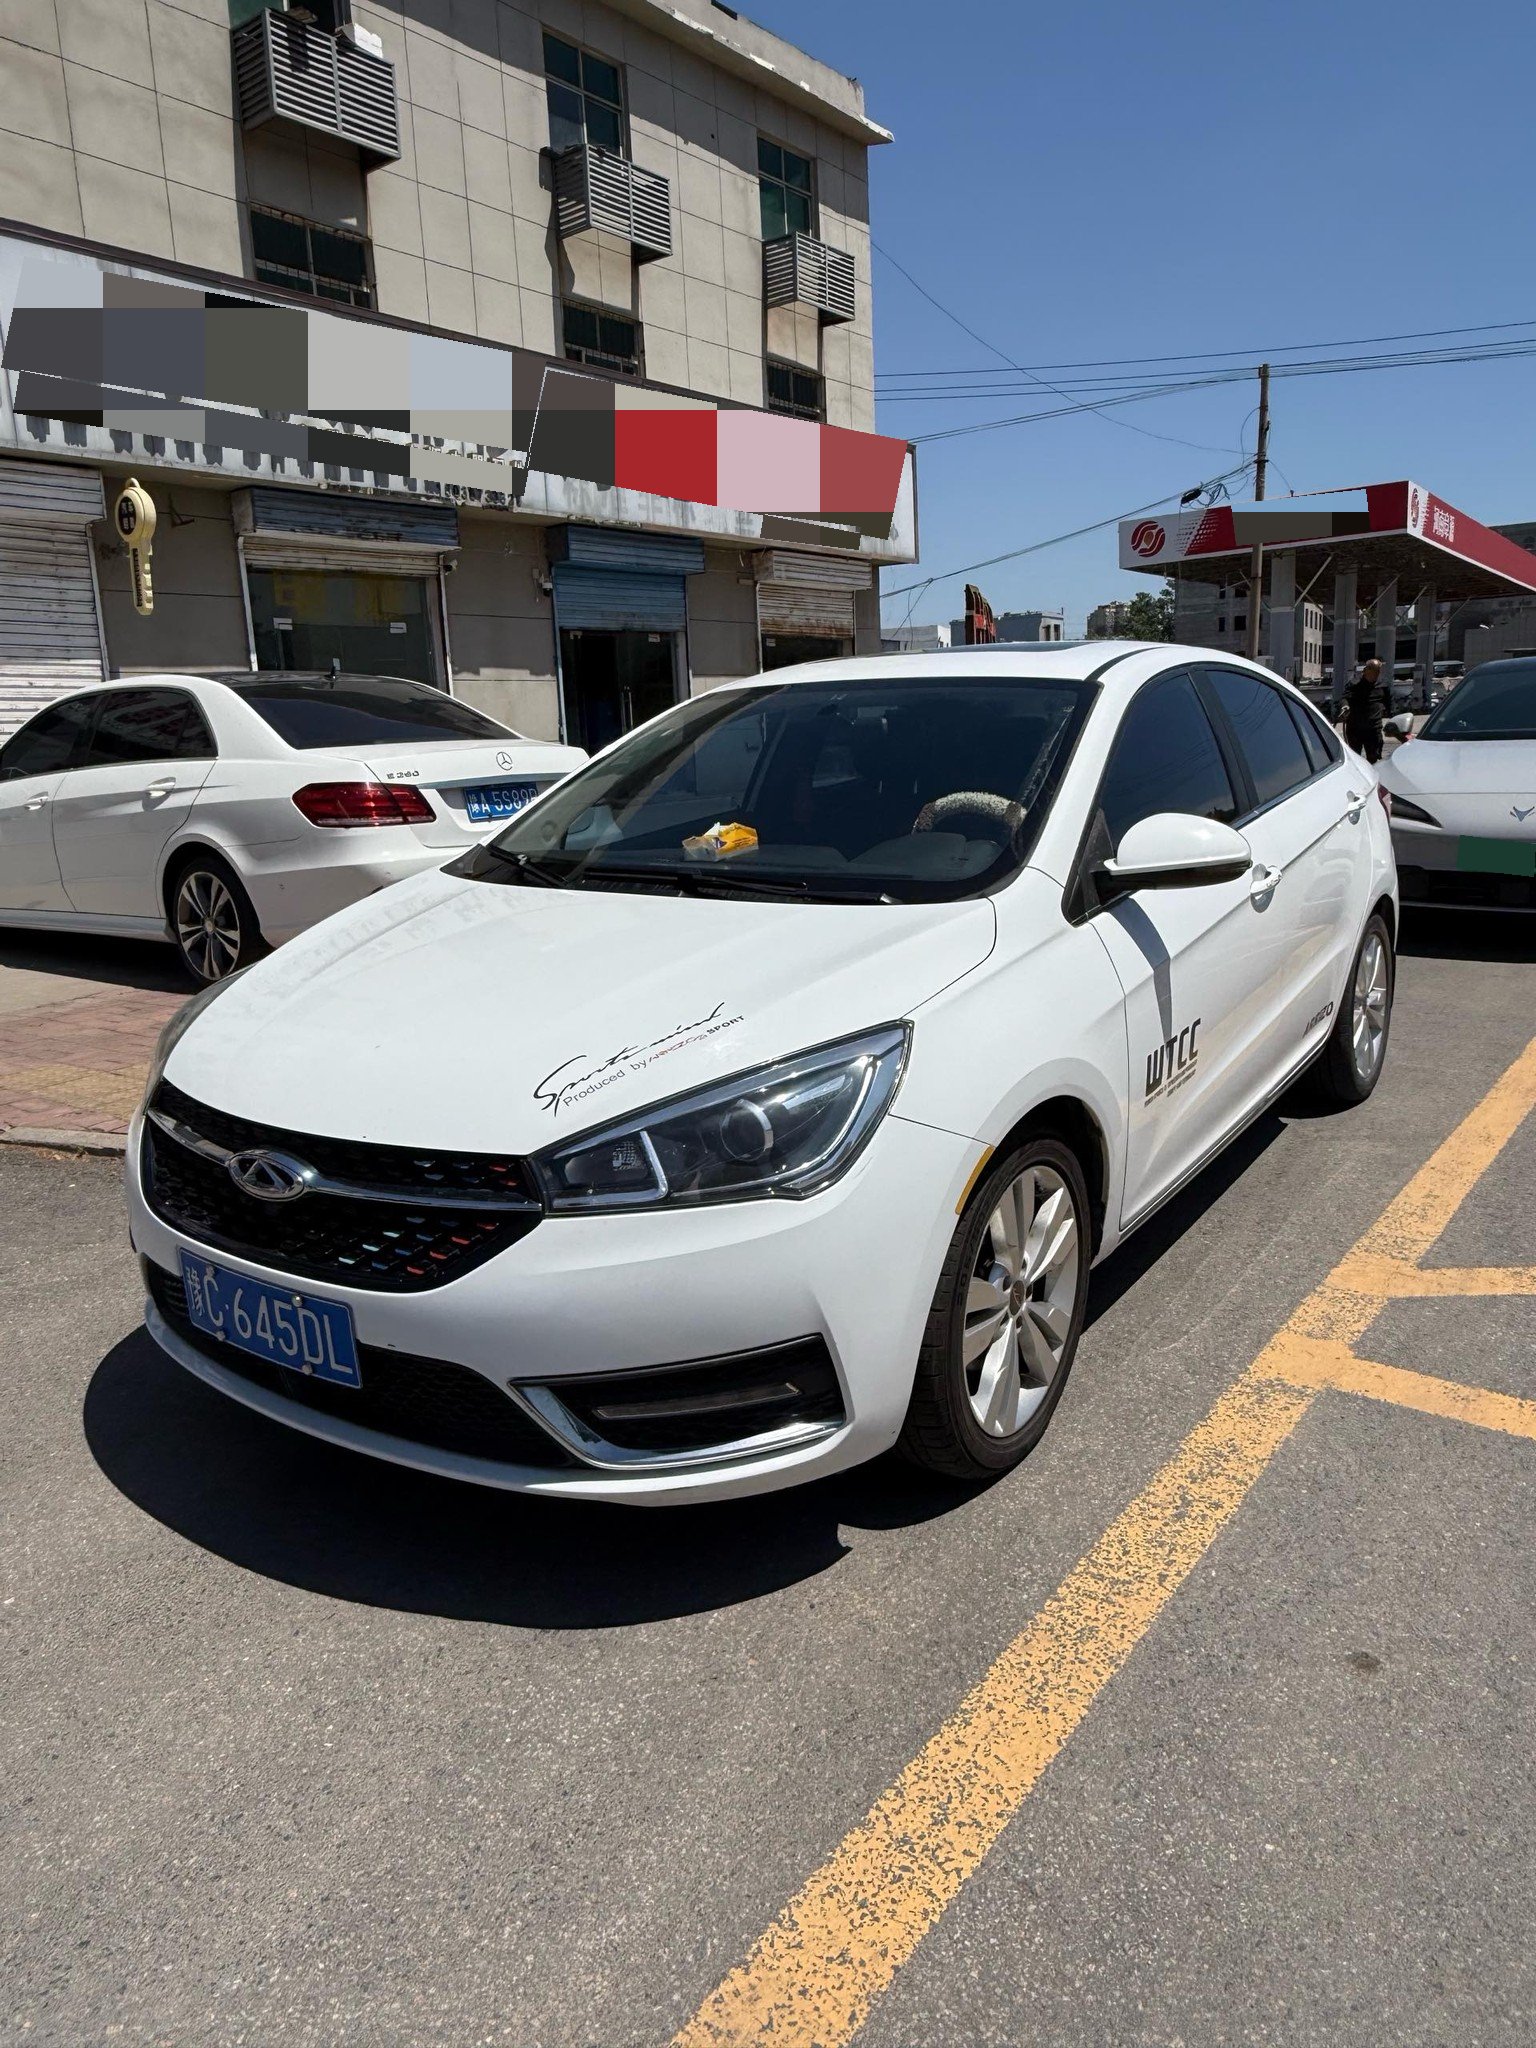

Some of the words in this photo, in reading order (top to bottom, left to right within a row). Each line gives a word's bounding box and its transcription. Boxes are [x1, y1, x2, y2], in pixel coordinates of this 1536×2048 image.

[562, 1069, 626, 1107] Produced
[630, 1059, 648, 1073] by
[1145, 1017, 1202, 1097] WTCC
